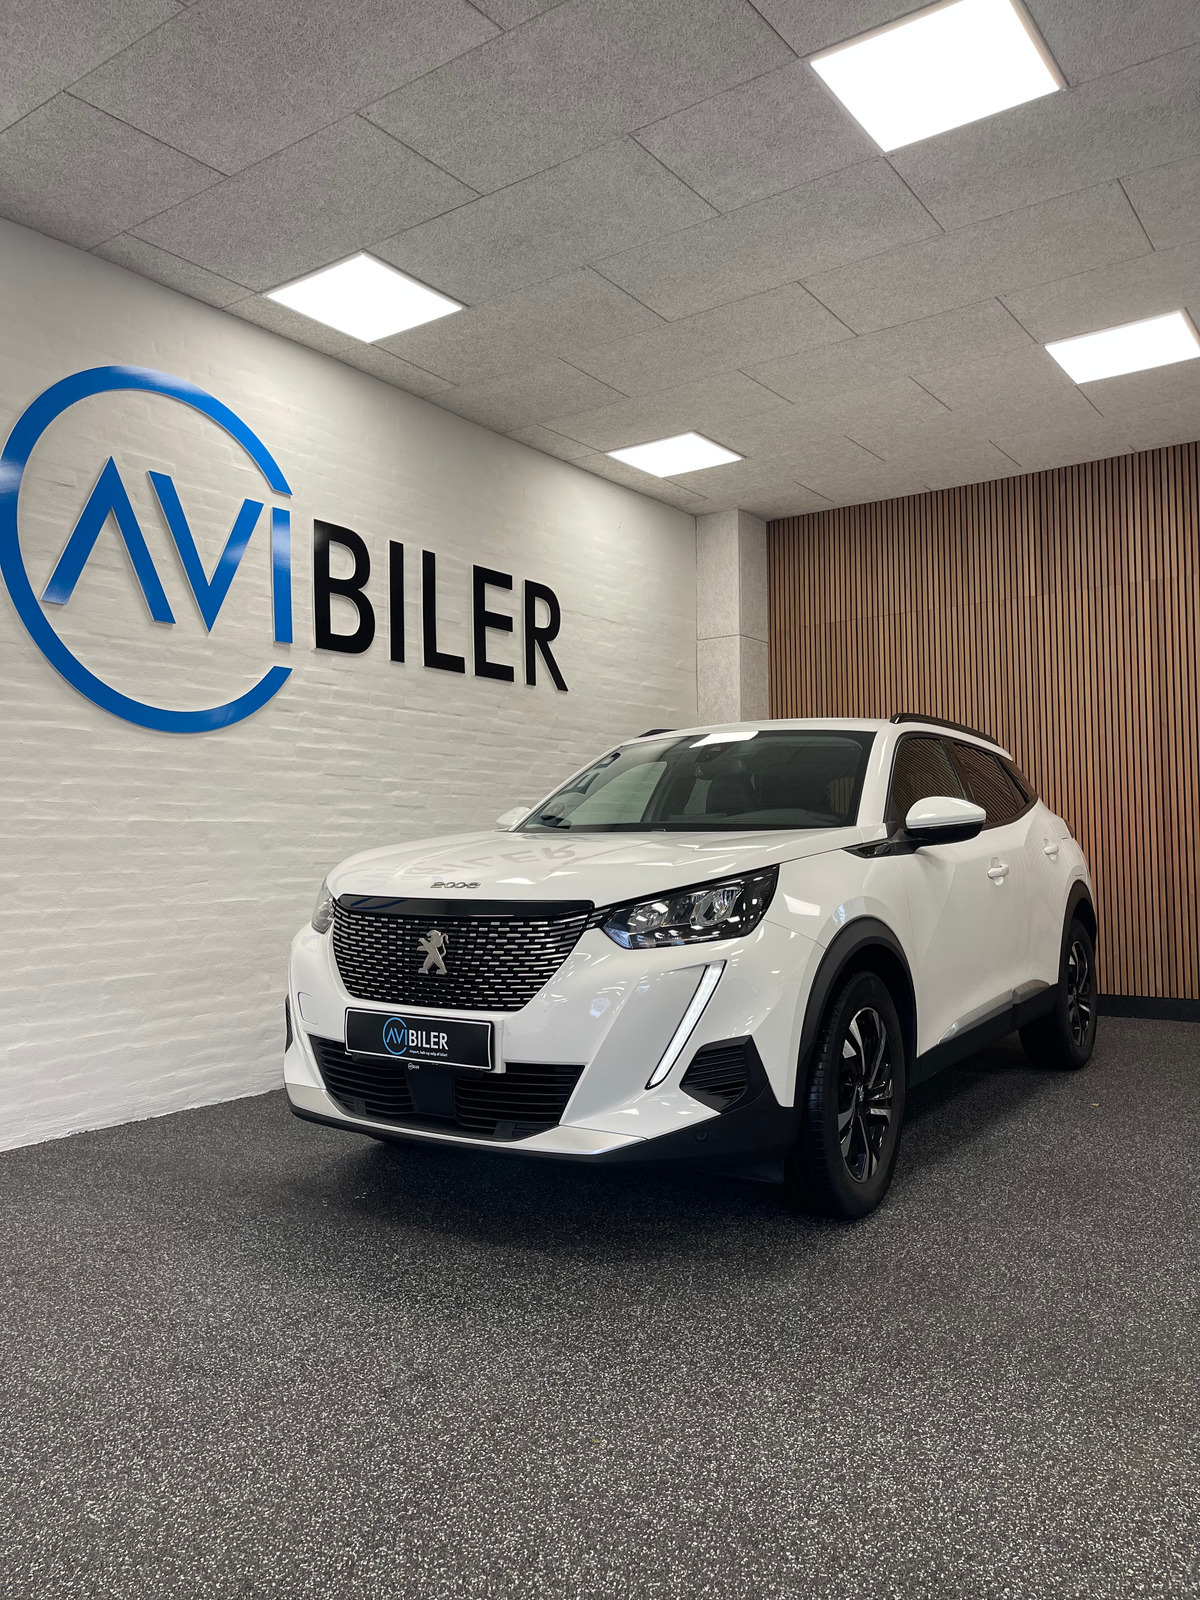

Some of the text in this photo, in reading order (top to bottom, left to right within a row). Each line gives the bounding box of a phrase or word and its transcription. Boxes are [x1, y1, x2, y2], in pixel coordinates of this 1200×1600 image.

[40, 456, 569, 692] AVI BILER
[408, 1029, 449, 1050] BILER
